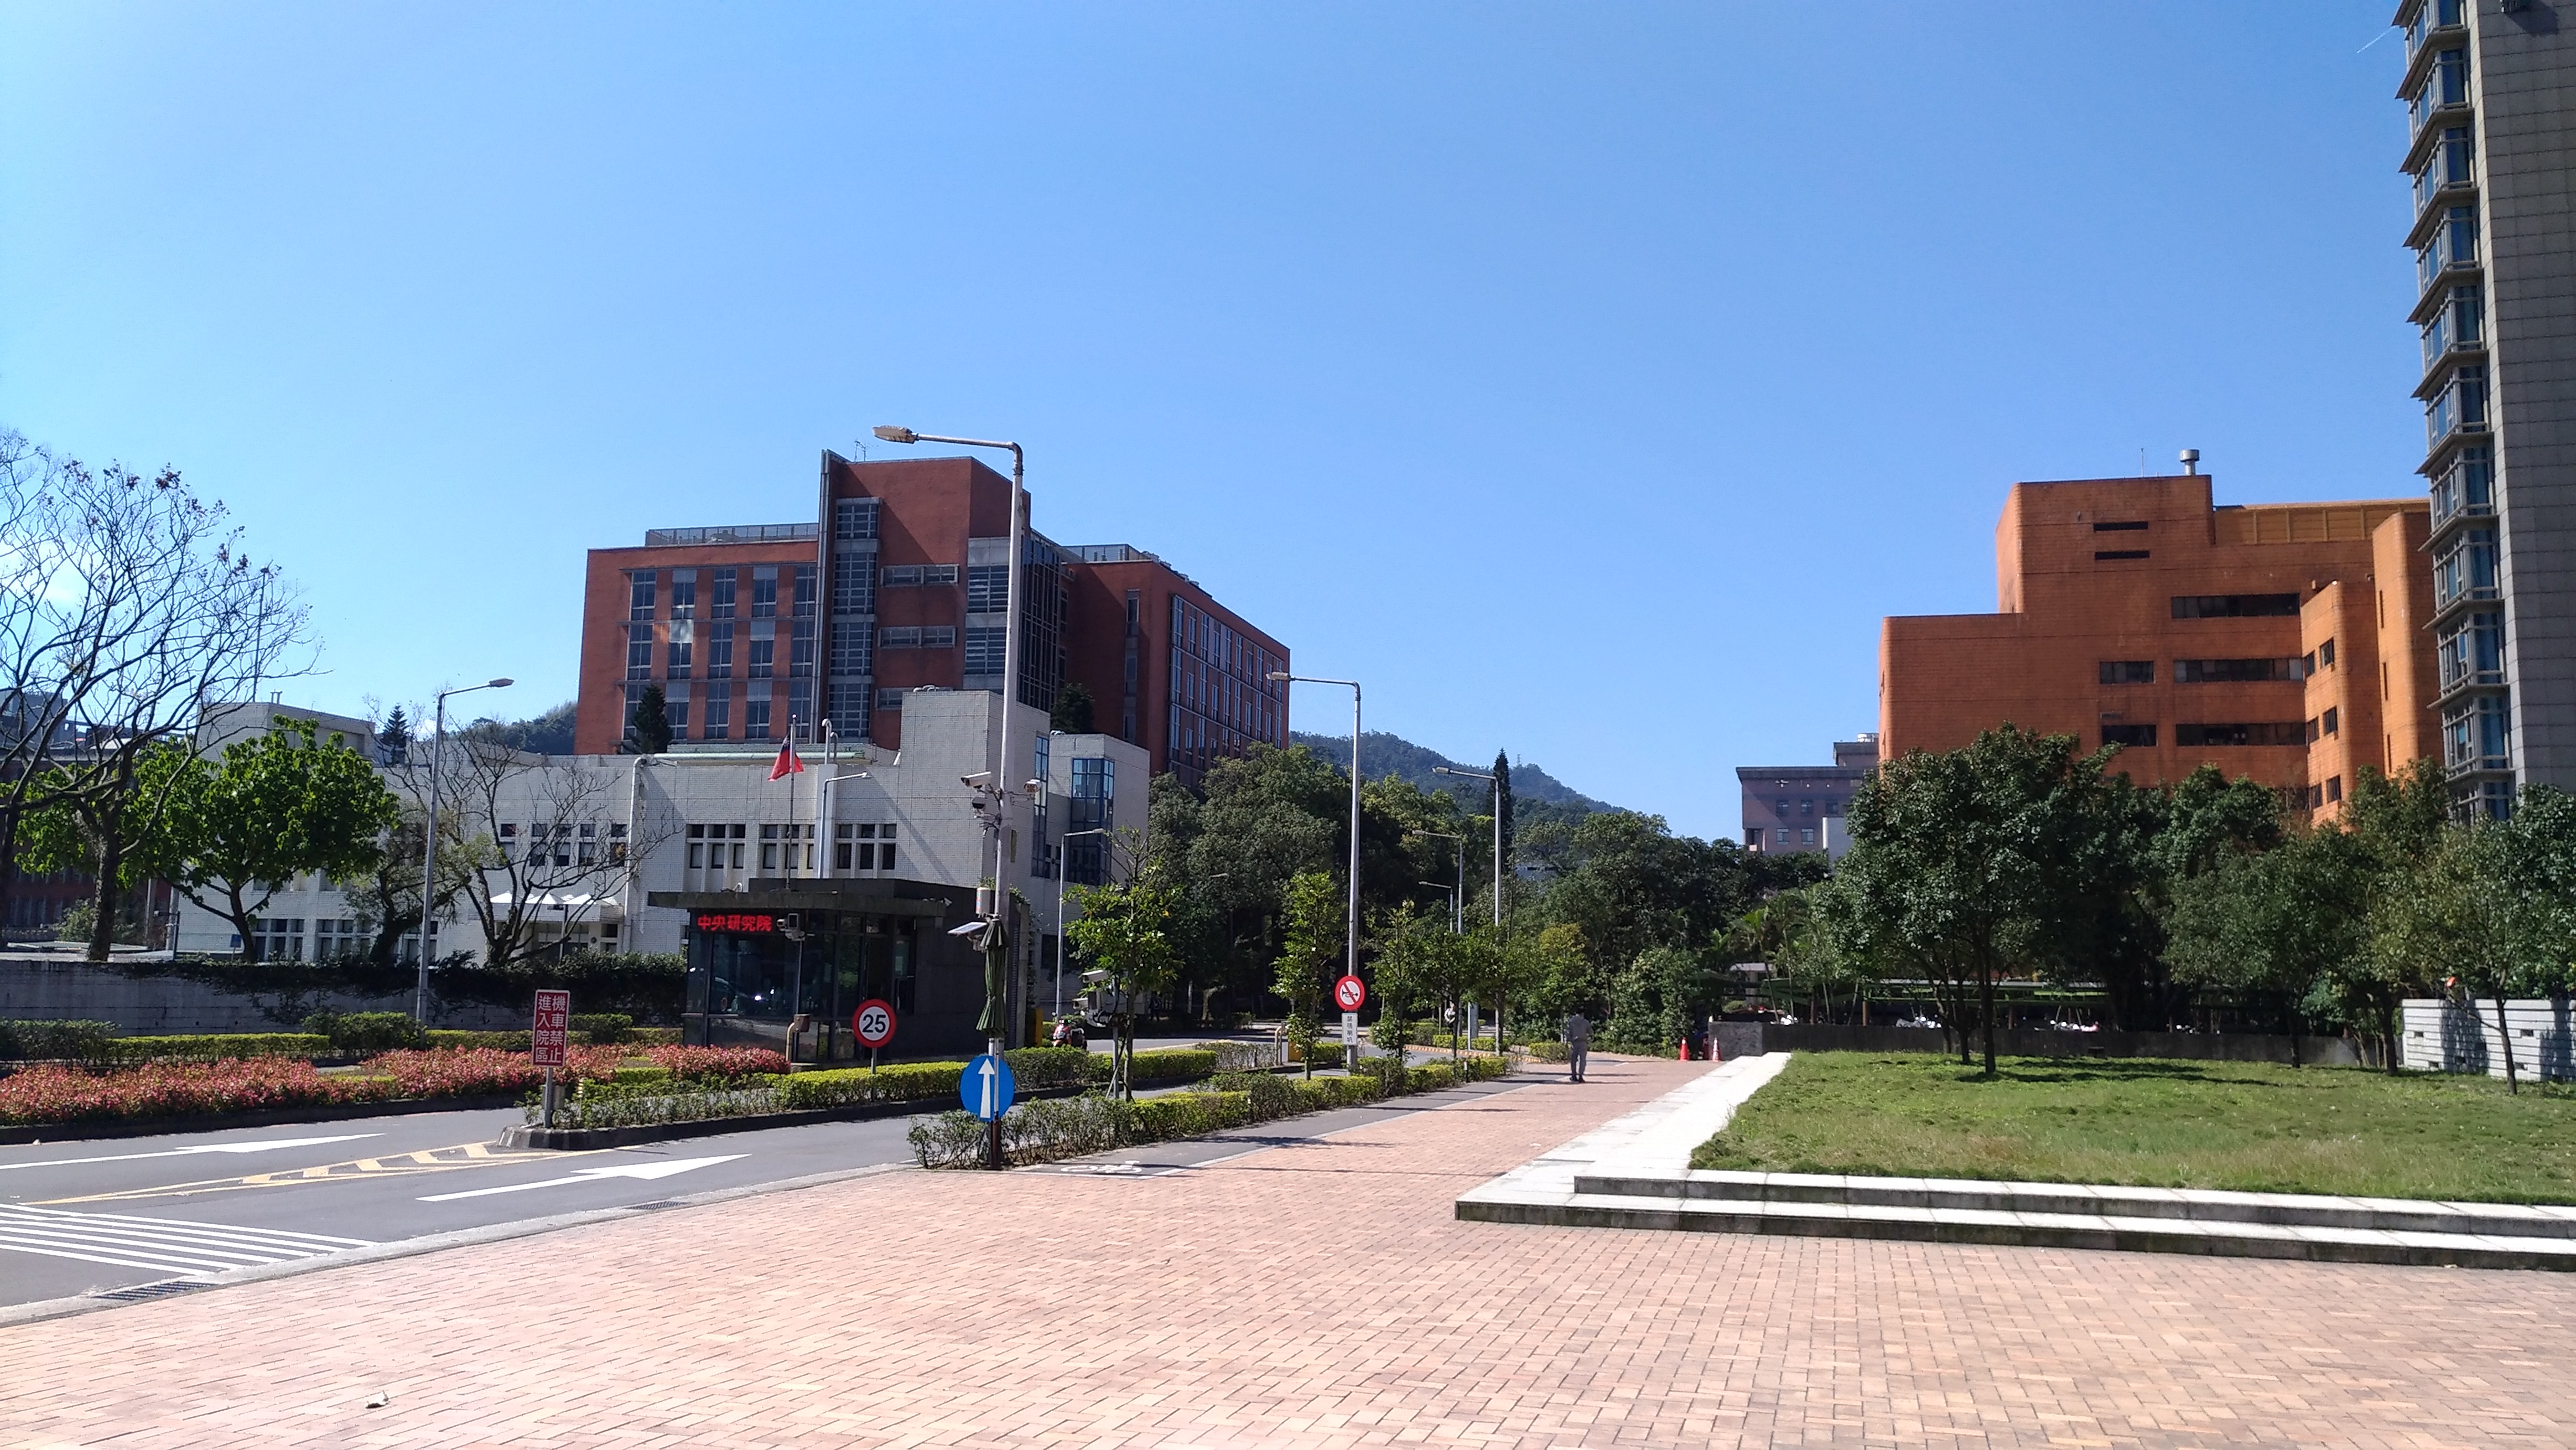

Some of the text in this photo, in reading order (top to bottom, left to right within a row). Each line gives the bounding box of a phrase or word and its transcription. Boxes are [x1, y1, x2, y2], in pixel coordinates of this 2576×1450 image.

[697, 914, 772, 931] 中央研究院
[535, 995, 552, 1063] 進入院區
[548, 996, 565, 1063] 機車禁止
[862, 1013, 886, 1033] 25
